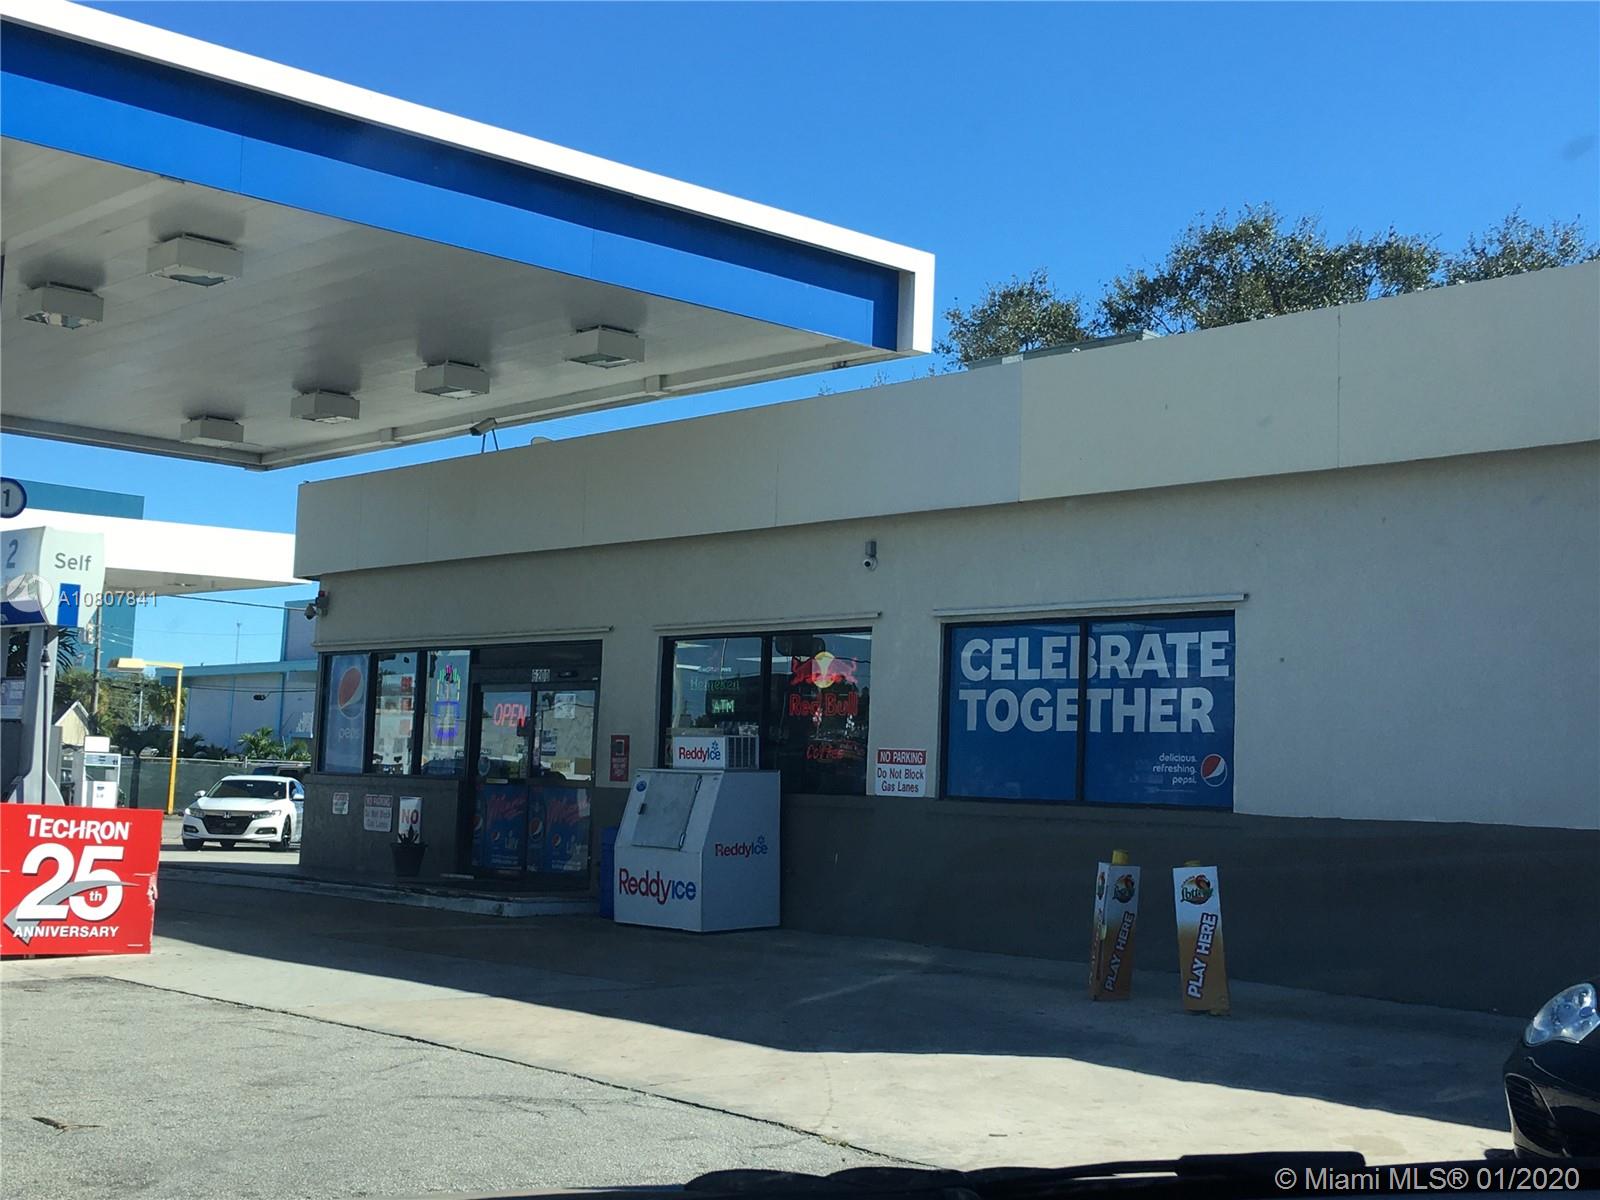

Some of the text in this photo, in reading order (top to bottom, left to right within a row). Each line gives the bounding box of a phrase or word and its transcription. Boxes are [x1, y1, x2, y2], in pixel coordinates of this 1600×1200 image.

[2, 489, 10, 507] 1
[6, 539, 19, 569] 2
[54, 552, 92, 571] Self
[960, 630, 1230, 682] CELEBRATE
[494, 703, 528, 728] OPEN
[712, 698, 736, 713] ATM
[789, 692, 858, 717] Red Bull
[958, 687, 1215, 734] TOGETHER
[879, 750, 924, 764] NO PARKING
[877, 768, 924, 780] Do Not Block
[881, 780, 919, 793] Gas Lanes
[401, 809, 419, 825] NO
[26, 814, 131, 844] TECHRON
[15, 843, 125, 922] 25
[88, 890, 103, 903] th
[13, 925, 120, 939] ANNIVERSARY
[1104, 953, 1121, 992] PLAY
[1116, 910, 1136, 951] HERE
[1187, 912, 1218, 999] PLAY HERE
